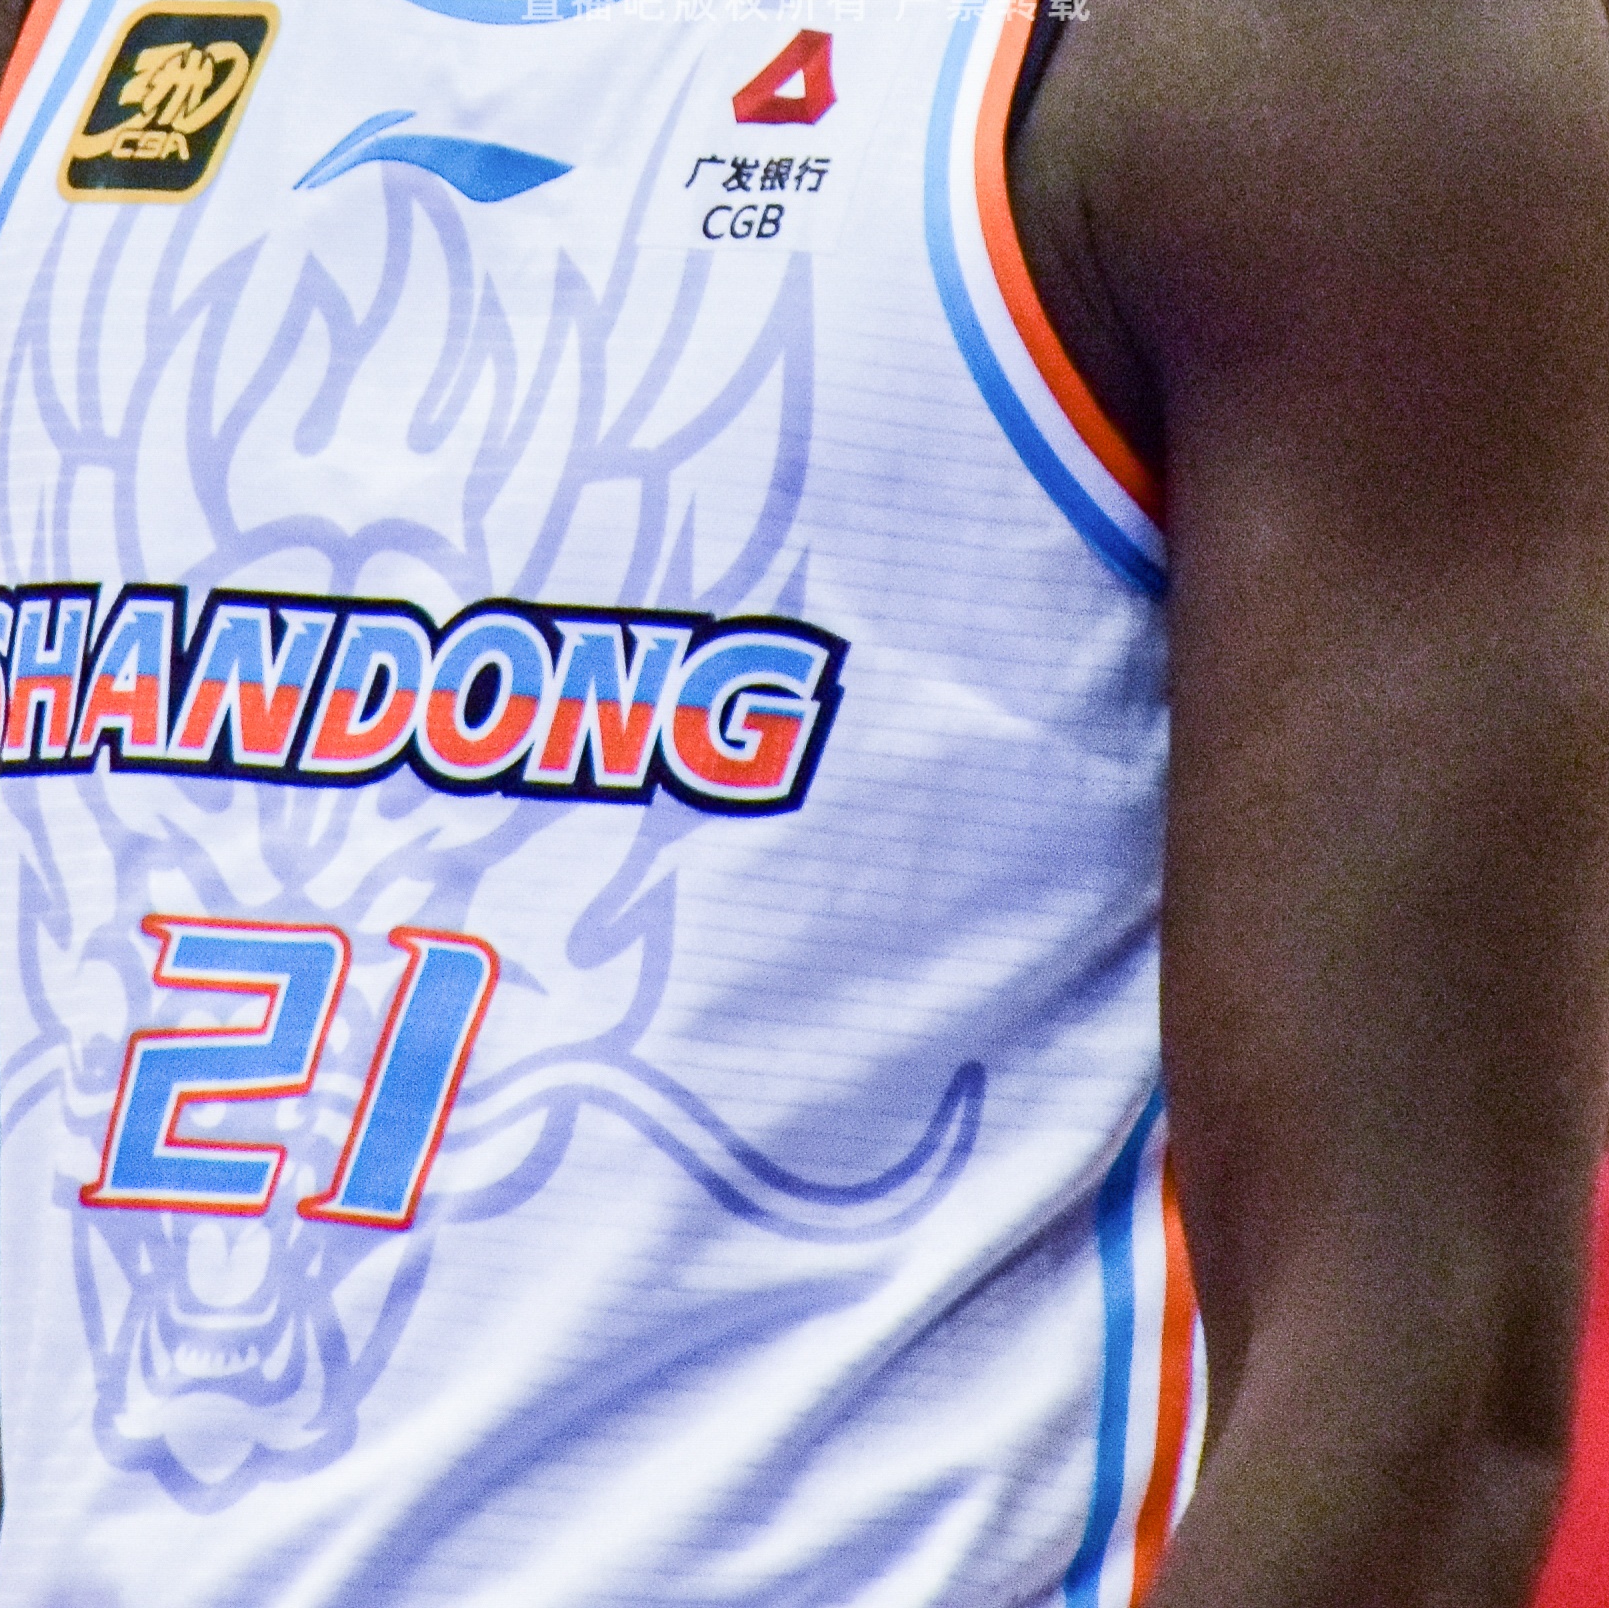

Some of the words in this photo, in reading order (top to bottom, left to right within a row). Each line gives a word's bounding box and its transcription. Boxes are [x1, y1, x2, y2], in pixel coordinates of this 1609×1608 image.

[110, 129, 190, 161] CBA
[685, 155, 830, 193] 广发银行
[701, 203, 784, 240] CGB
[79, 913, 501, 1231] 21
